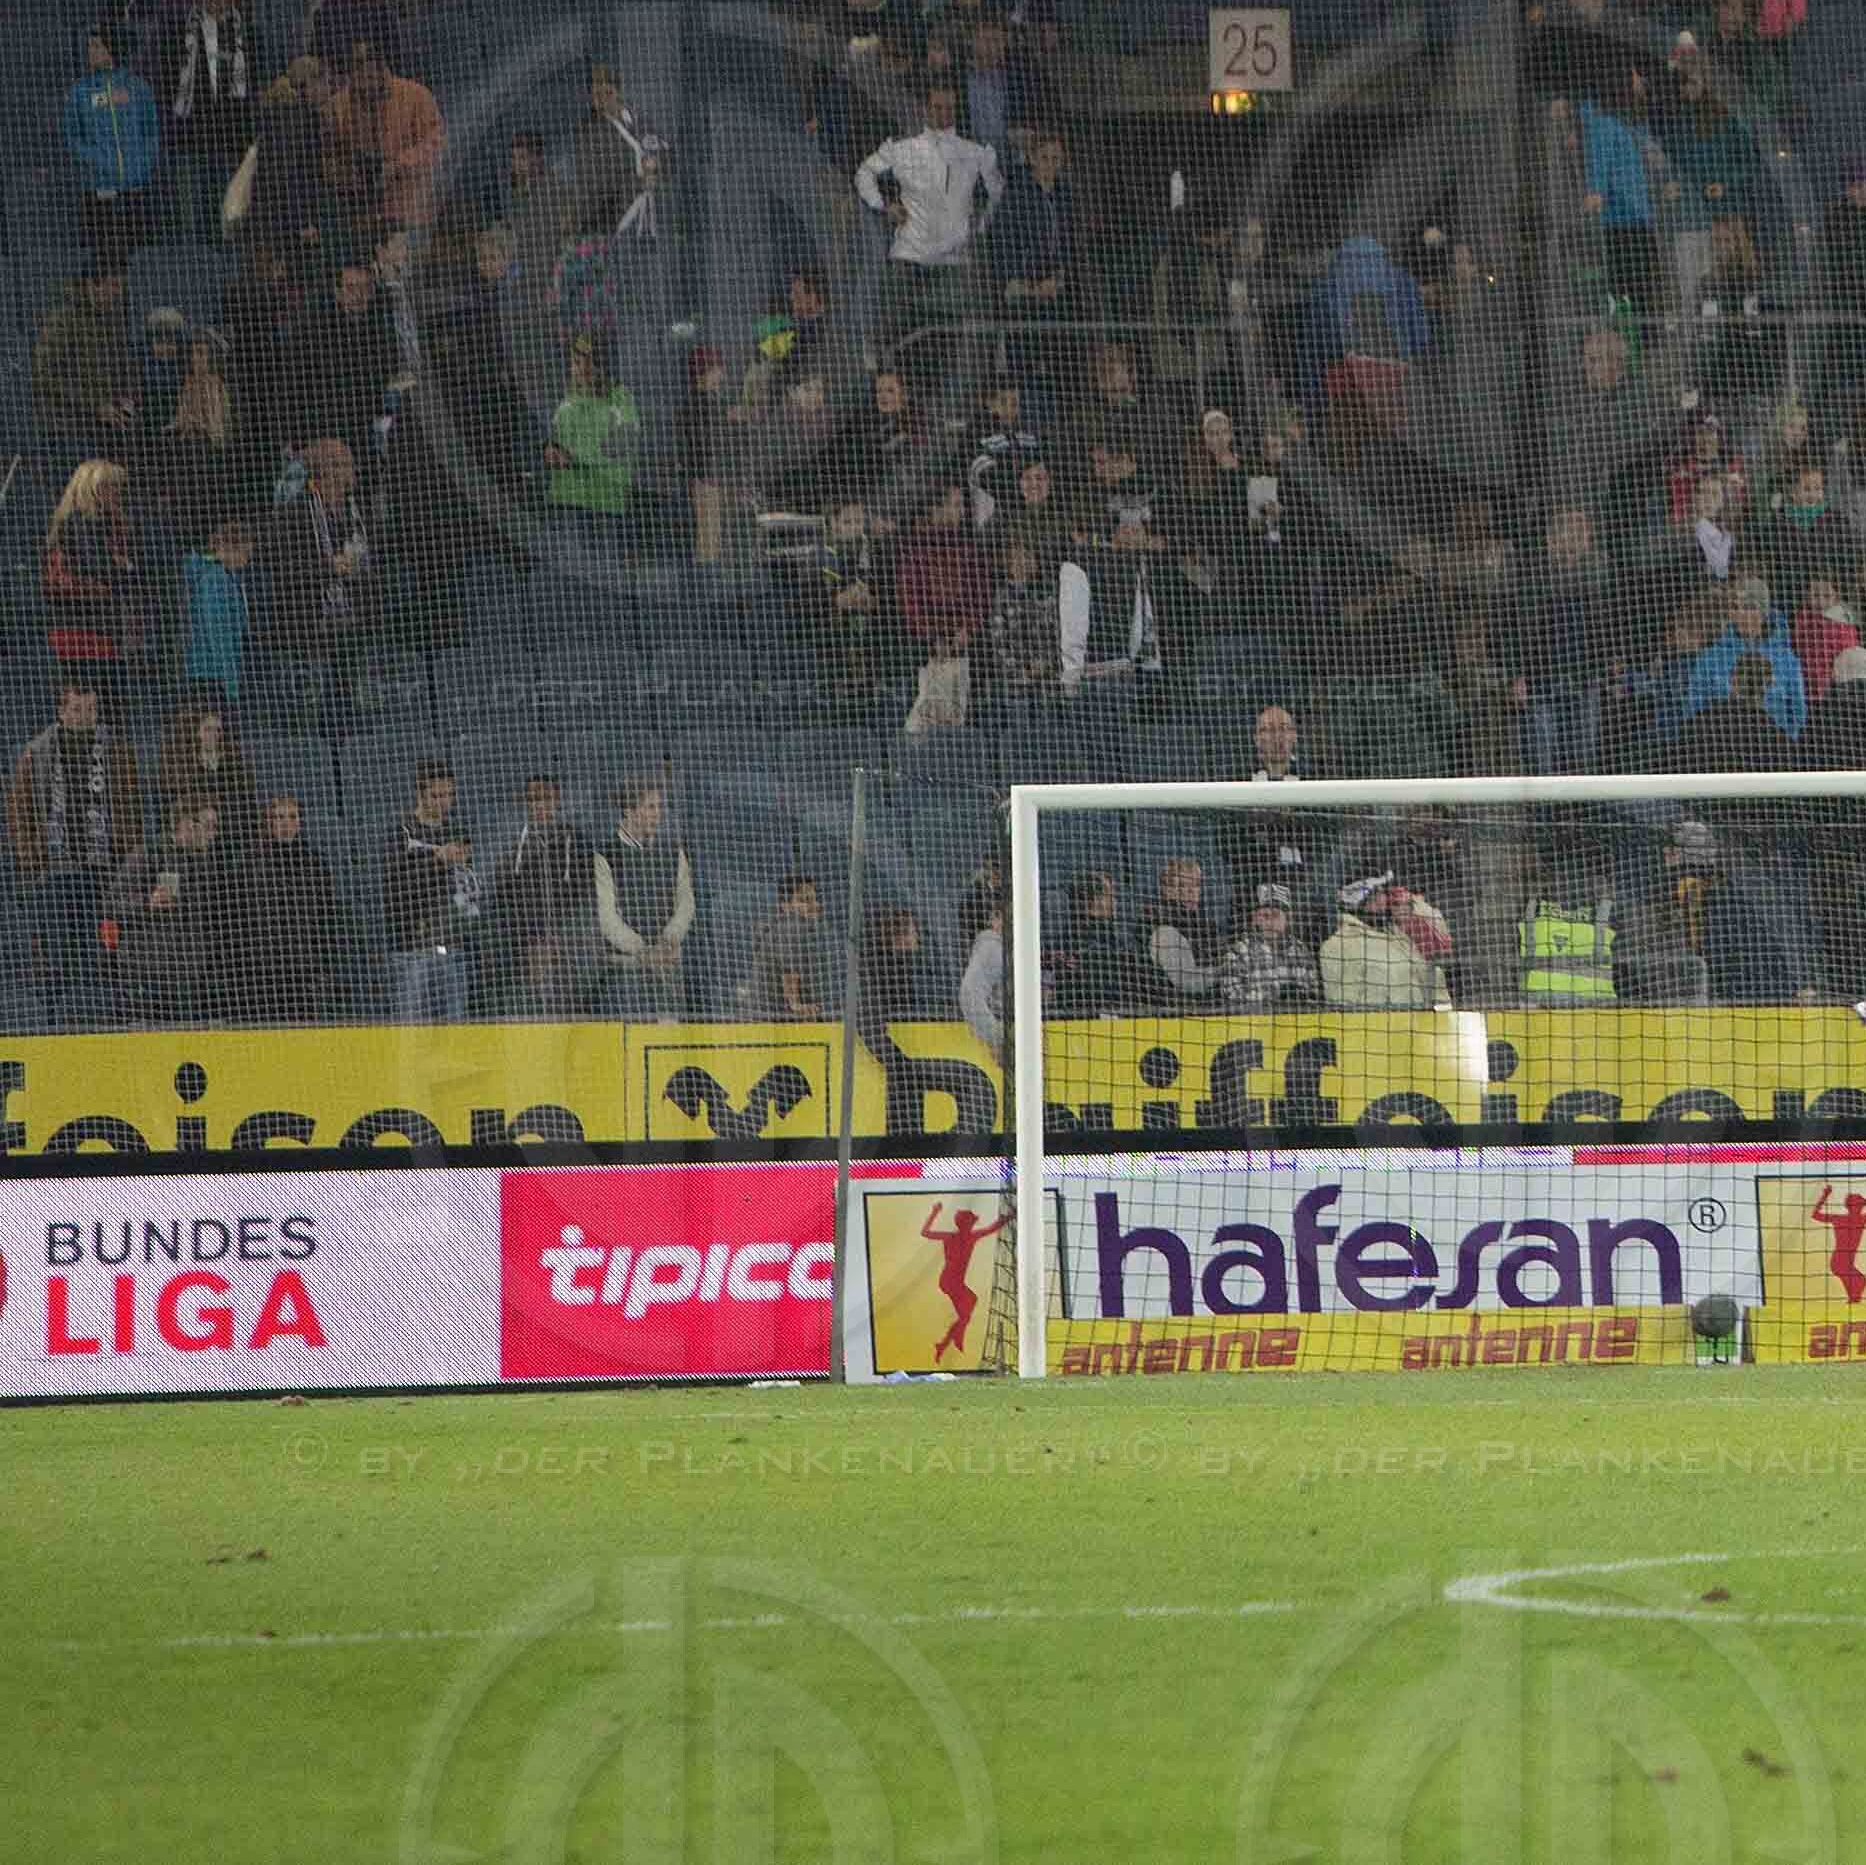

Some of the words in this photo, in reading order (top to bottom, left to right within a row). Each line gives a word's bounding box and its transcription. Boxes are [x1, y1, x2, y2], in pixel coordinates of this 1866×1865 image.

[1224, 22, 1276, 76] 25
[46, 1215, 317, 1265] BUNDES
[1095, 1184, 1683, 1318] hafesan
[47, 1270, 328, 1355] LIGA
[1064, 1321, 1300, 1375] antenne
[1402, 1314, 1637, 1370] antenne
